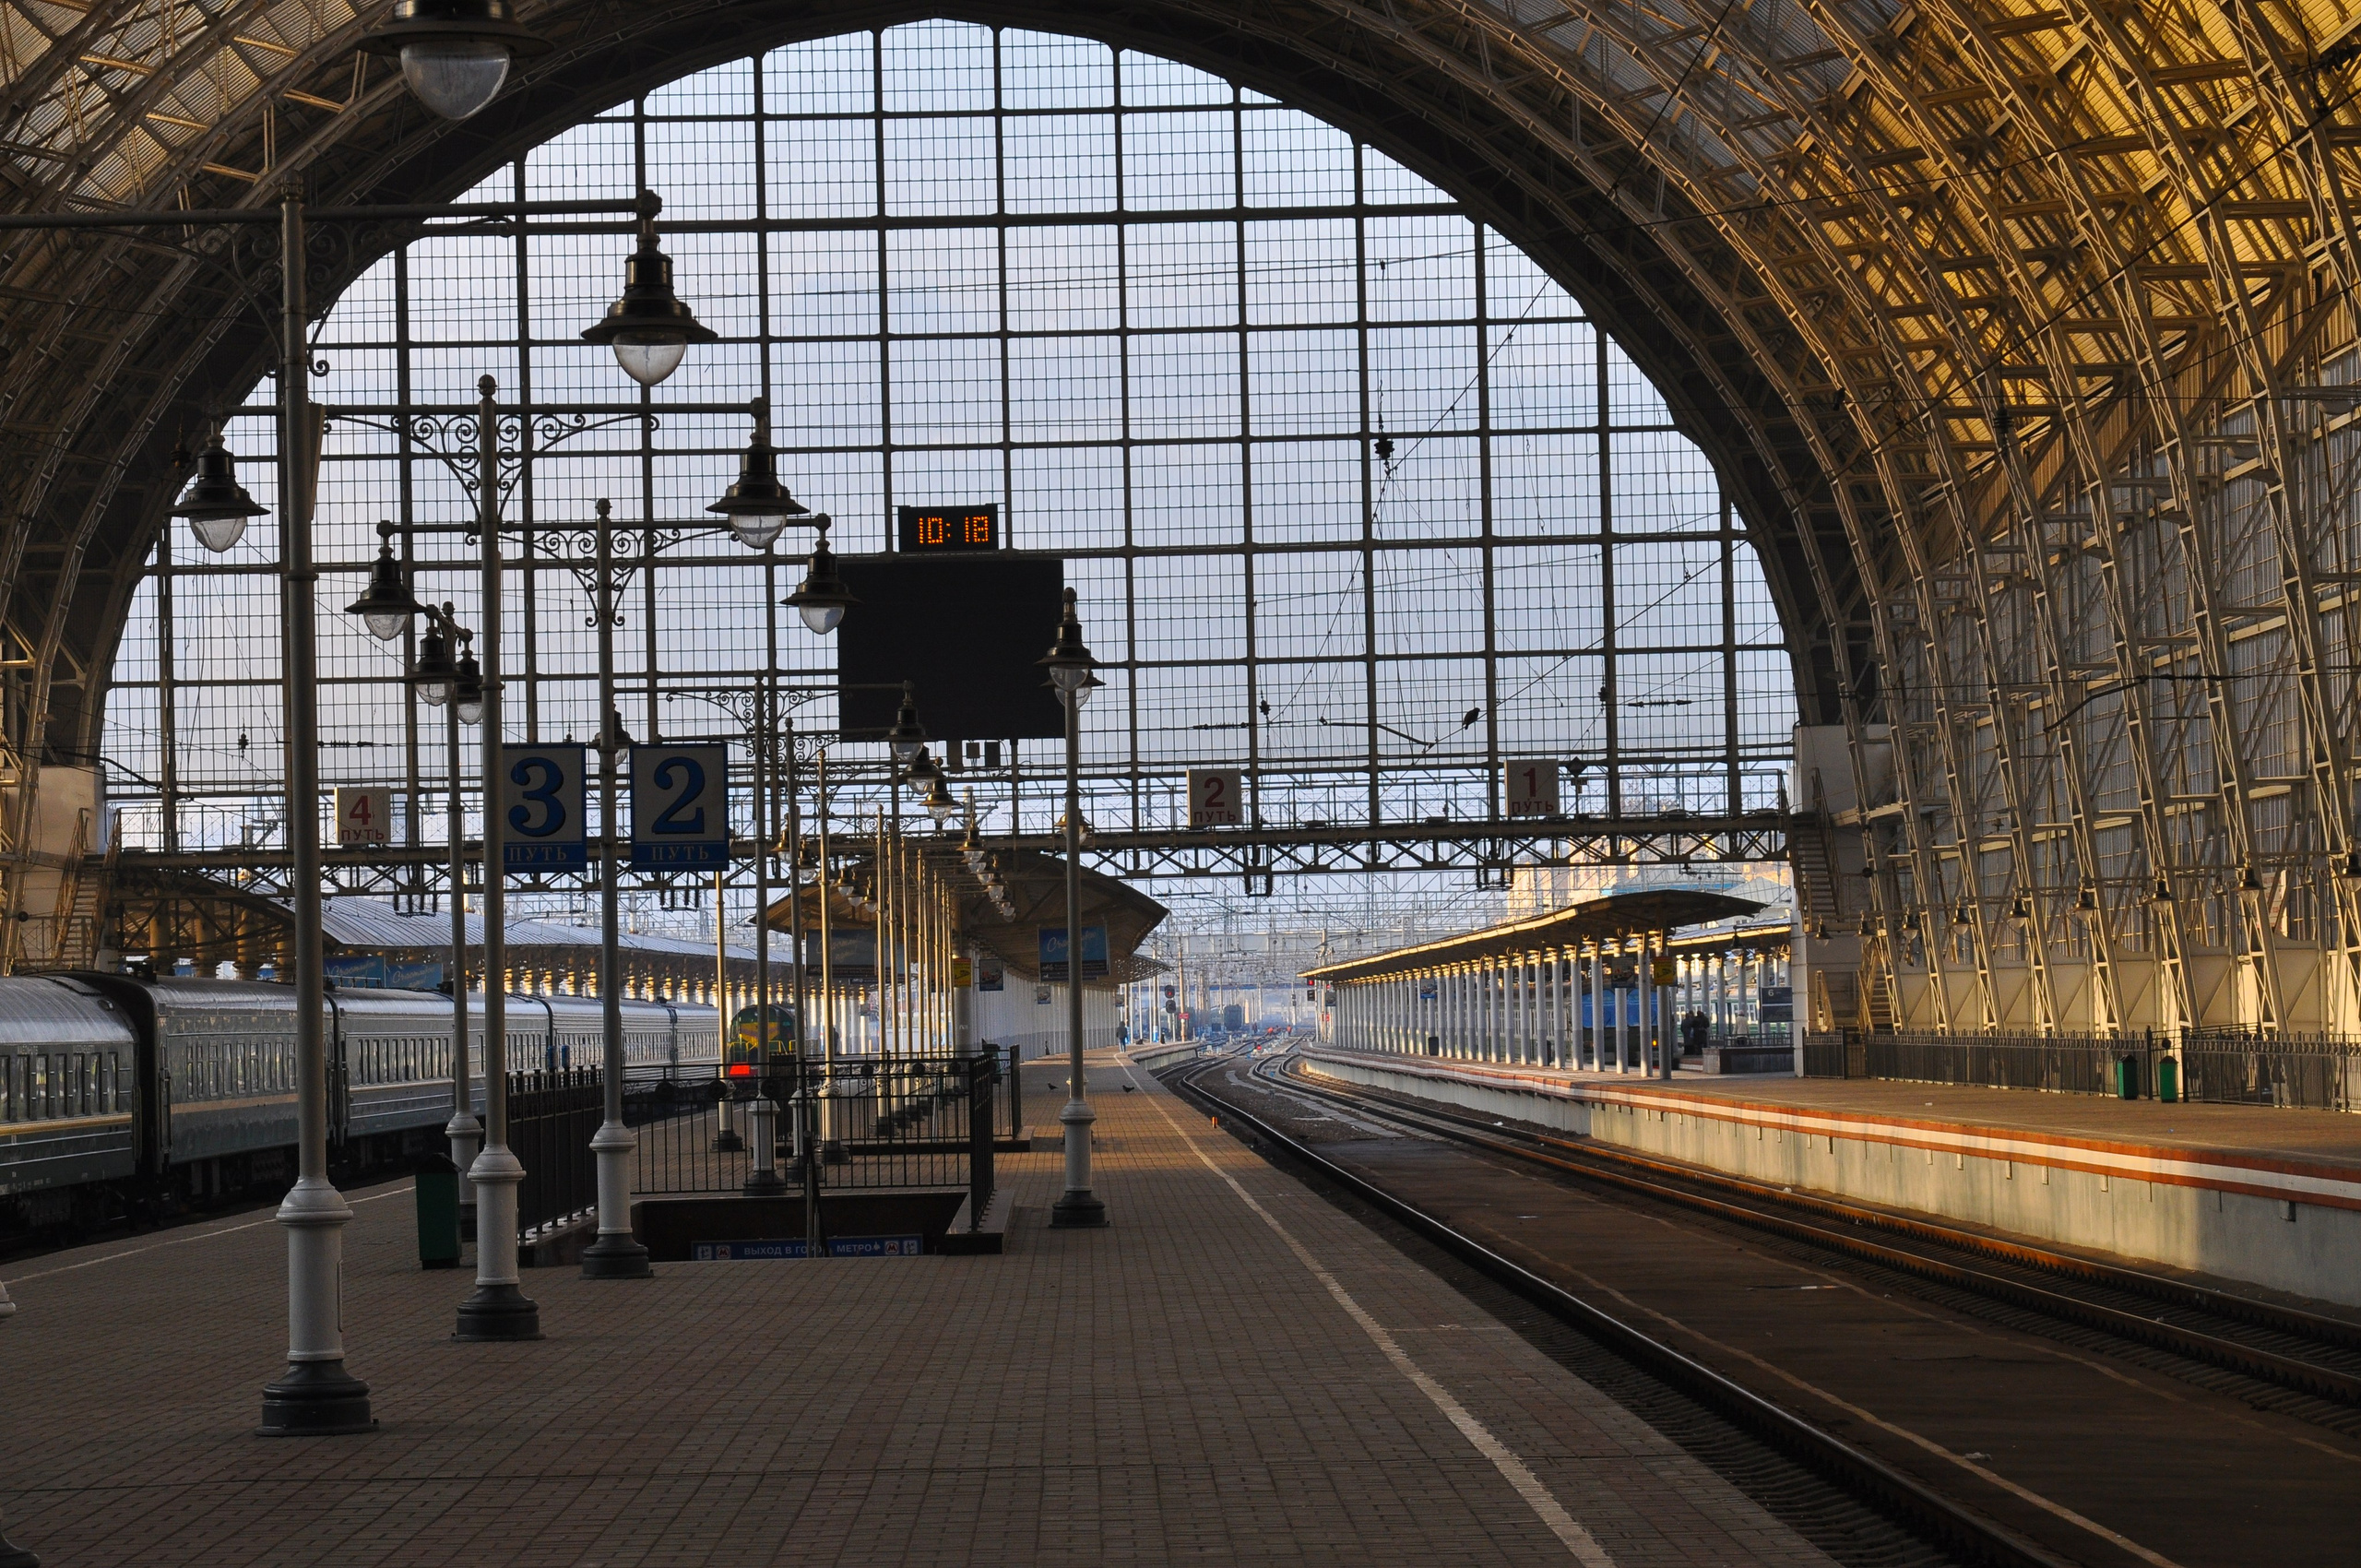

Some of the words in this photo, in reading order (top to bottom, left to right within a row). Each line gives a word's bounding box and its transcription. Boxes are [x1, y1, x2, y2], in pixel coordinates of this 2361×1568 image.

[919, 517, 989, 543] 10:18
[1204, 777, 1225, 807] 2
[1523, 767, 1536, 797] 1
[508, 756, 566, 837] 3
[651, 756, 706, 834] 2
[349, 795, 372, 825] 4
[1193, 811, 1236, 823] ПУТЬ
[1512, 801, 1554, 813] ПУТЬ
[340, 829, 385, 840] ПУТЬ
[509, 846, 567, 861] ПУТЬ
[651, 845, 709, 861] ПУТЬ
[743, 1246, 782, 1256] ВЫХОД
[785, 1246, 792, 1254] В
[836, 1244, 872, 1253] МЕТРО
